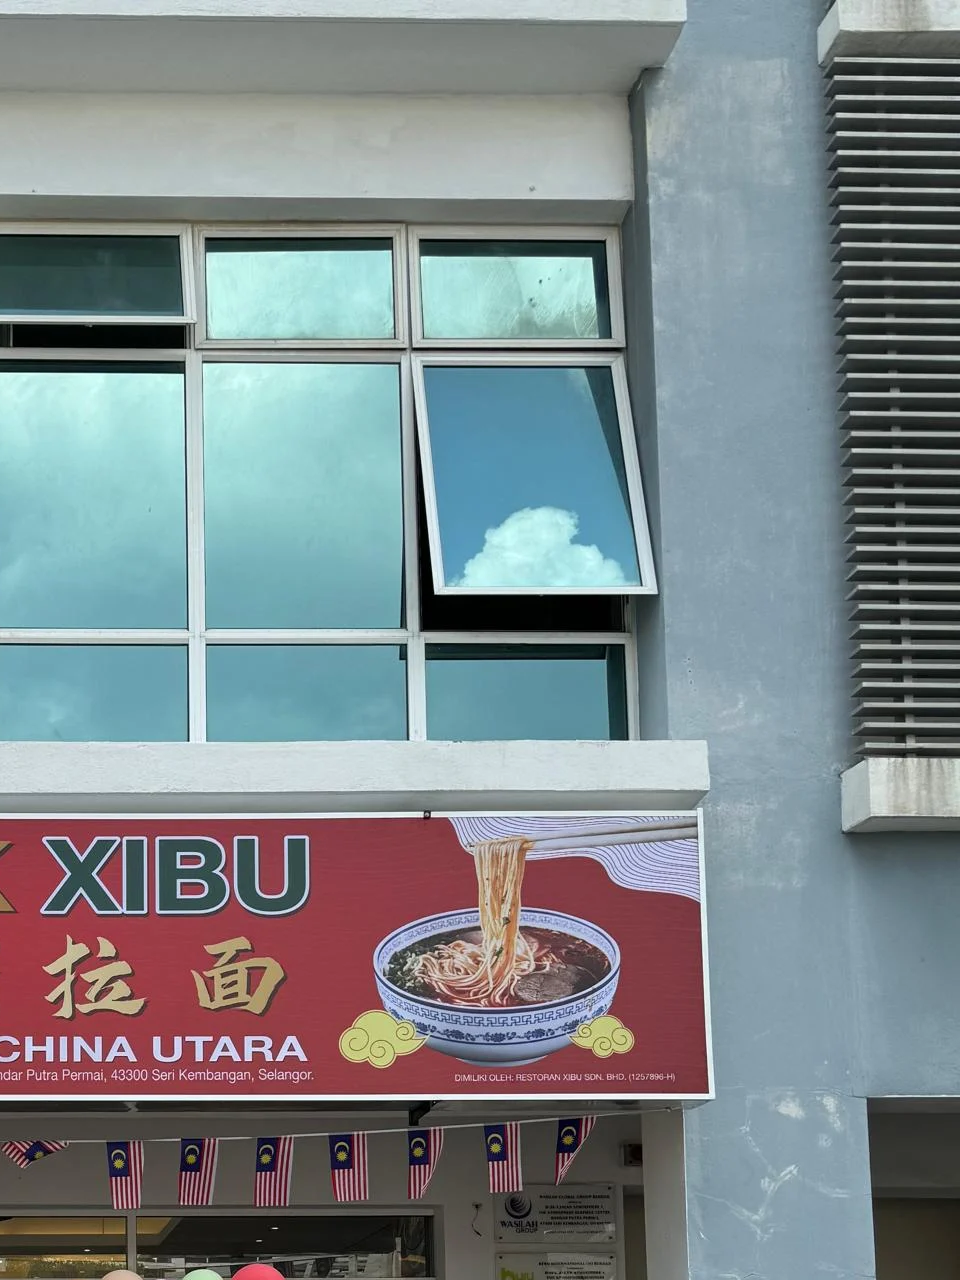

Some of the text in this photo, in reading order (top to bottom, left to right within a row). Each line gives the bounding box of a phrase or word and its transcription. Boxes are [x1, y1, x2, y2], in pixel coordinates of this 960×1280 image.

[40, 834, 310, 915] XIBU
[152, 1035, 308, 1063] UTARA
[26, 1068, 59, 1082] Putra
[62, 1068, 107, 1083] Permai,
[110, 1068, 148, 1082] 43300
[151, 1068, 175, 1082] Seri
[178, 1068, 255, 1085] Kembangan,
[258, 1068, 315, 1085] Selangor.
[454, 1073, 487, 1083] DIMILIKI
[489, 1073, 514, 1082] OLEH:
[515, 1073, 561, 1082] RESTORAN
[562, 1073, 583, 1081] XIBU
[584, 1073, 605, 1081] SDN.
[606, 1072, 627, 1081] BHD.
[500, 1220, 538, 1228] WASILAH
